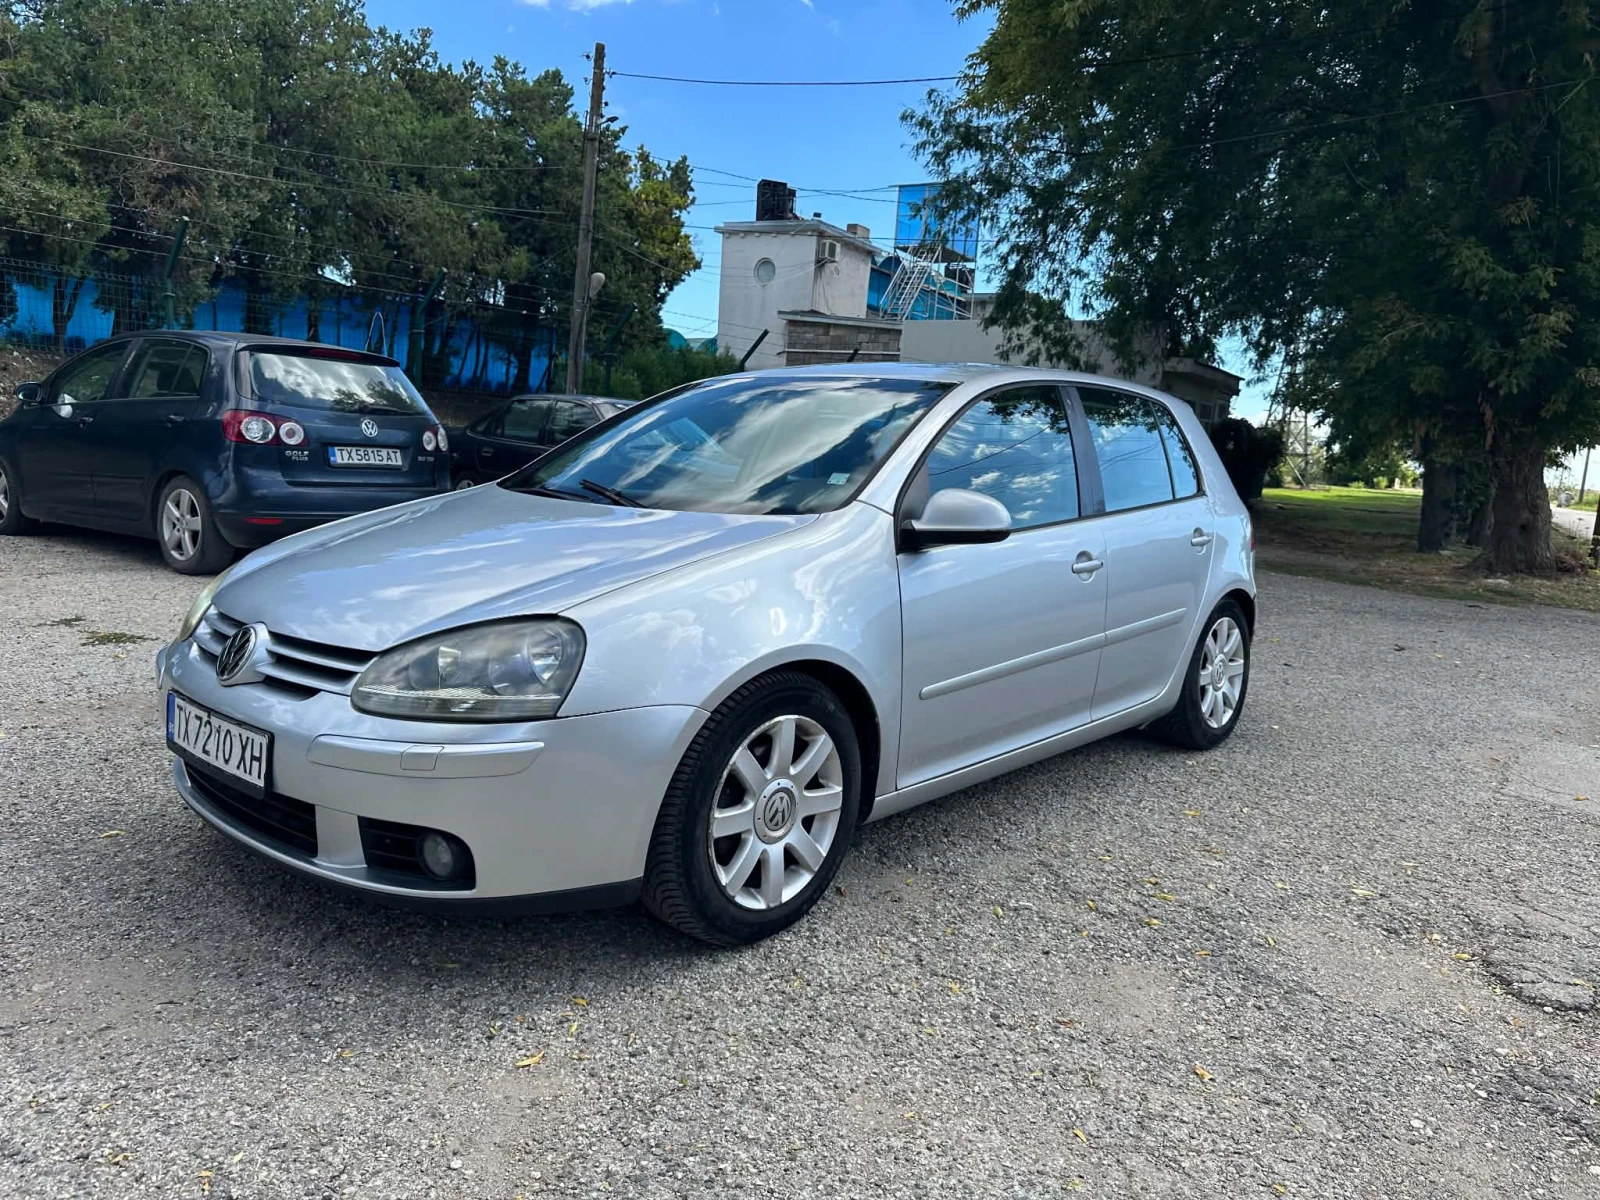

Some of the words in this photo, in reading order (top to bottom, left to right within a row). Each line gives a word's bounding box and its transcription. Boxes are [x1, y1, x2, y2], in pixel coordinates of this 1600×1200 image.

[362, 419, 379, 437] VW
[355, 449, 384, 462] 5815
[217, 626, 256, 681] VW
[193, 713, 234, 766] 7210
